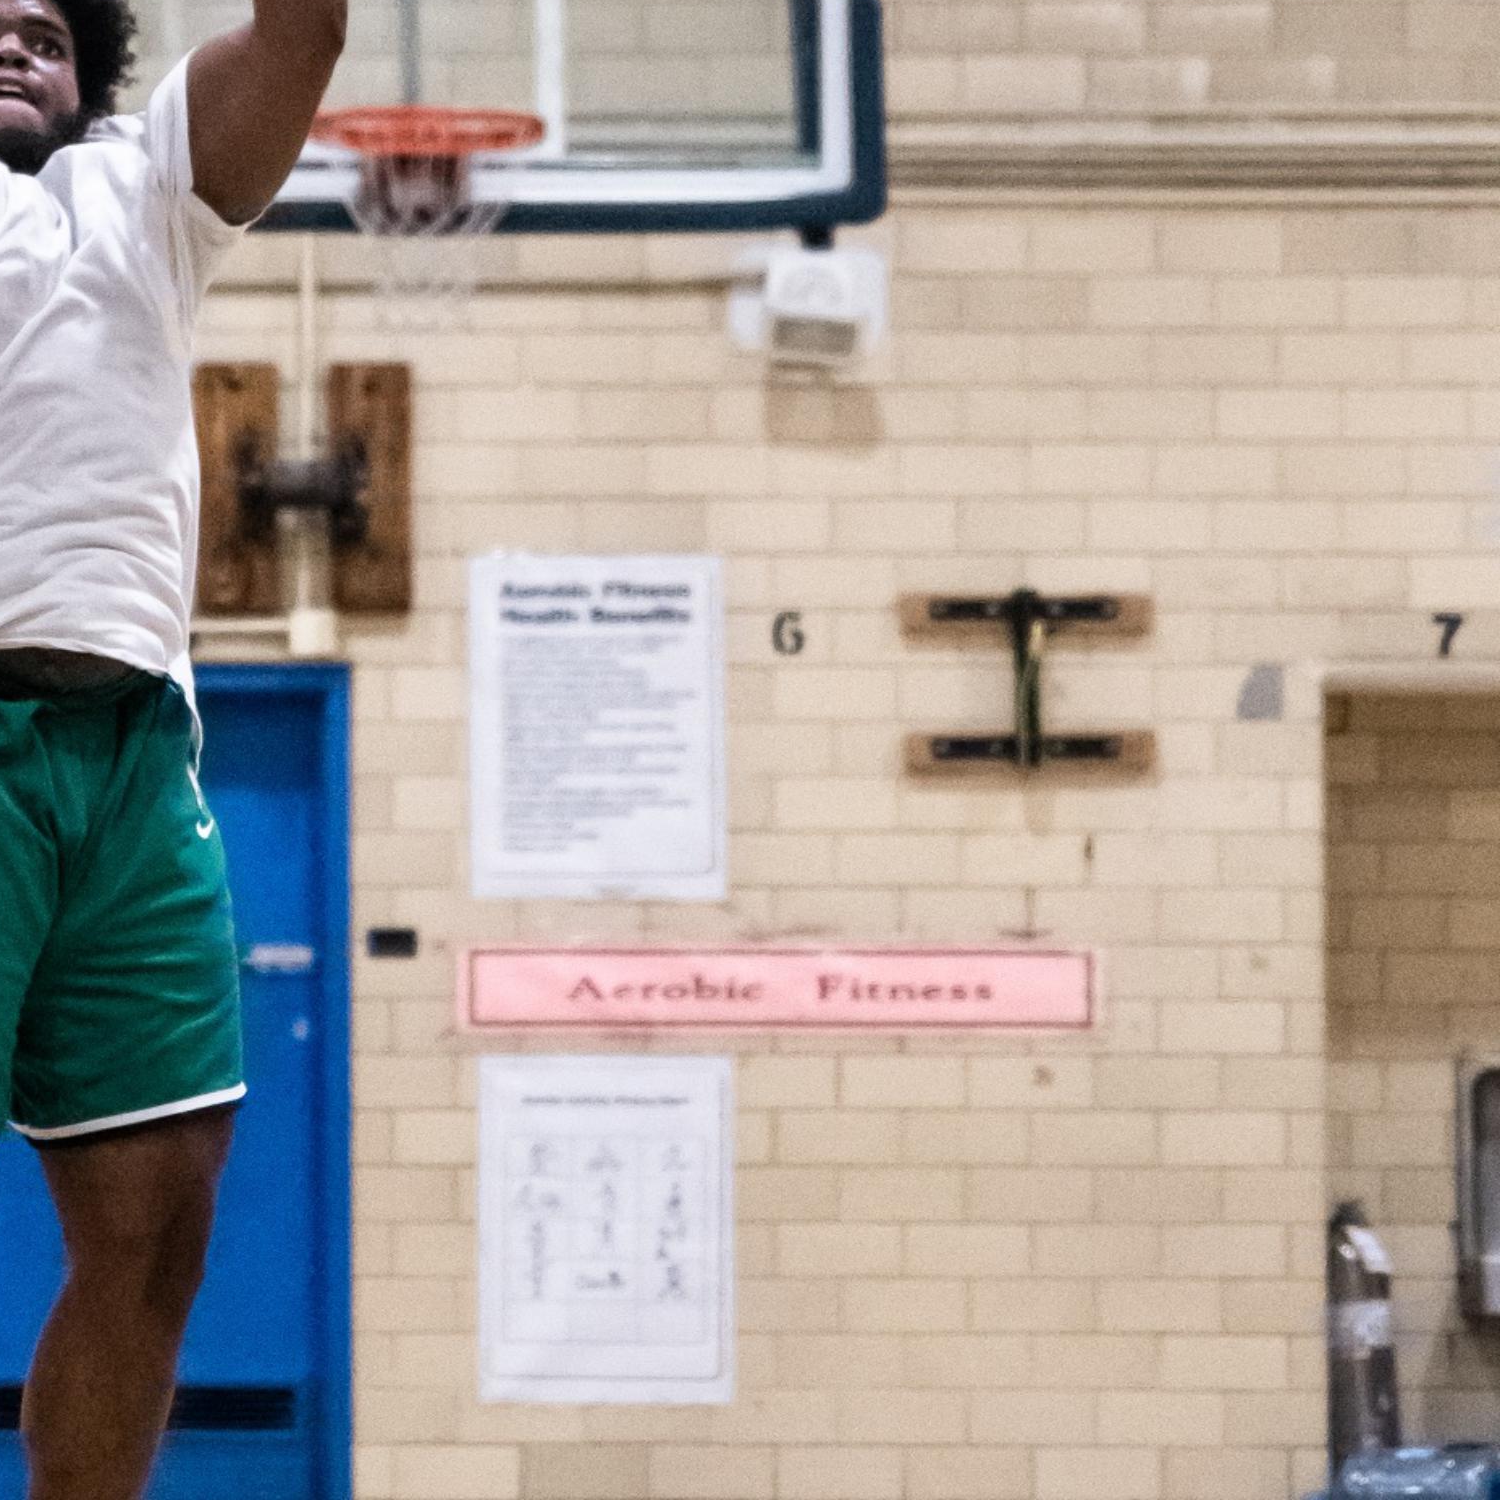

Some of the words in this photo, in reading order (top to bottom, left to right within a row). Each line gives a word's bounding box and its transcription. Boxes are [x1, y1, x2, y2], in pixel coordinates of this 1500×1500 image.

[772, 611, 805, 656] 6
[1431, 611, 1464, 659] 7
[567, 975, 766, 1002] Aerobic
[816, 973, 994, 1002] Fitness
